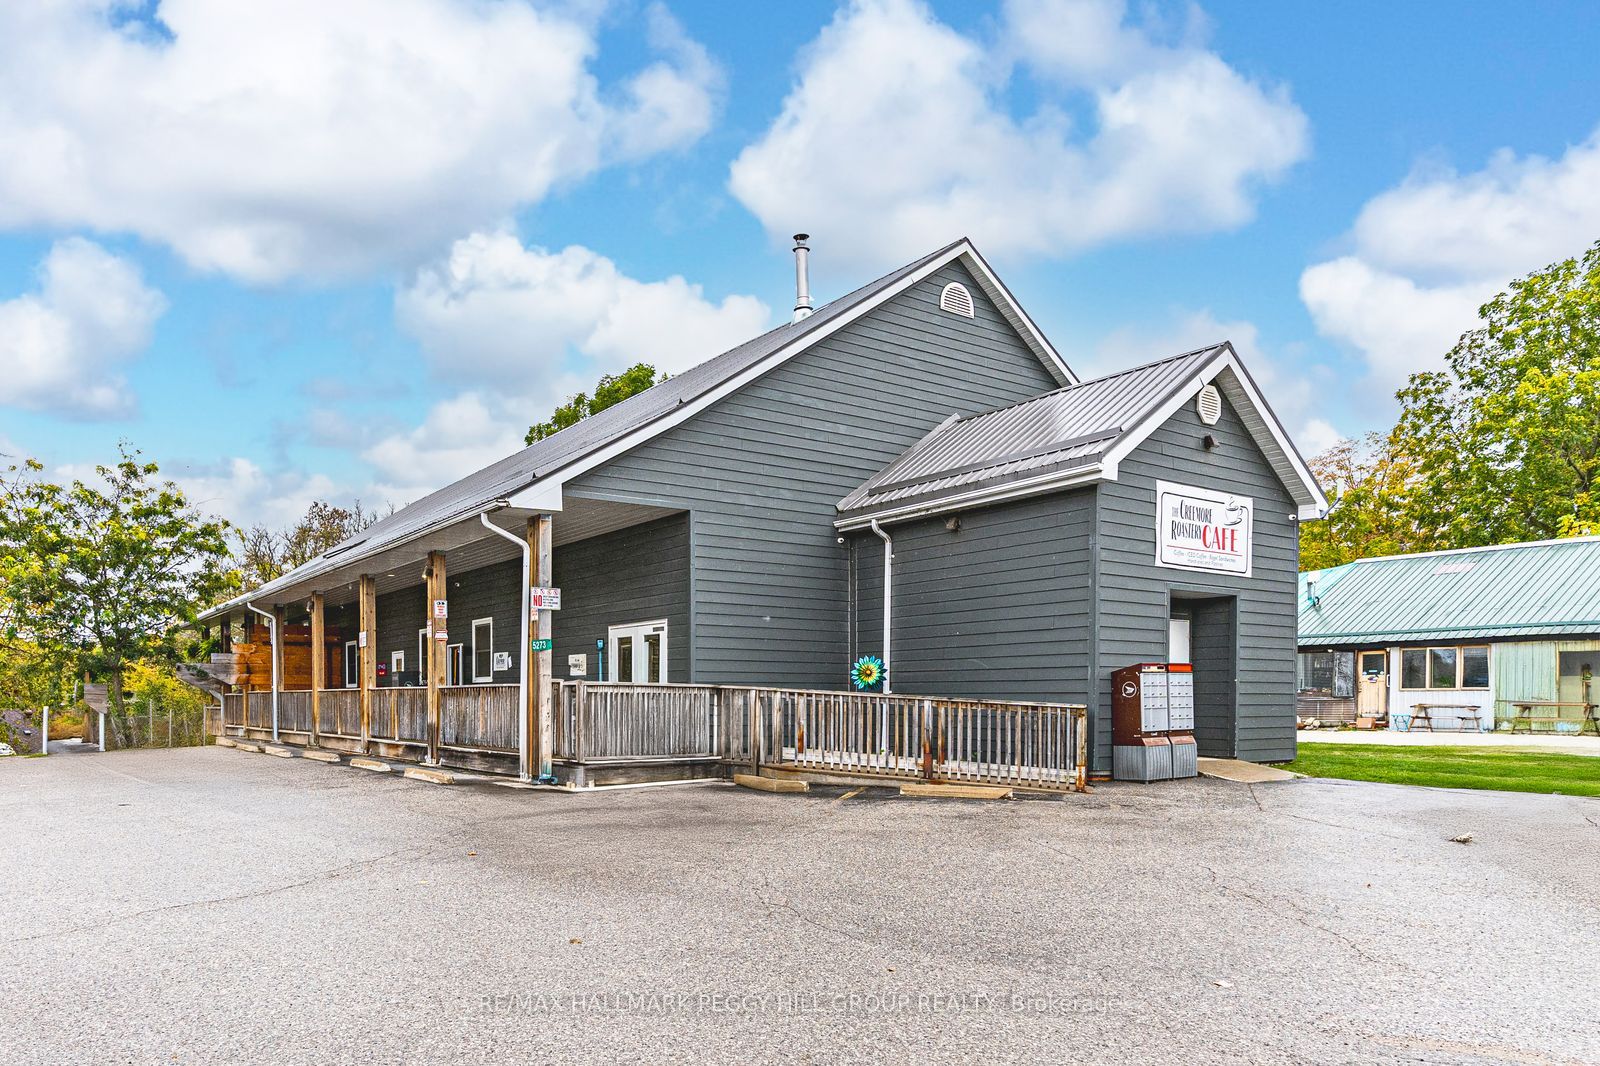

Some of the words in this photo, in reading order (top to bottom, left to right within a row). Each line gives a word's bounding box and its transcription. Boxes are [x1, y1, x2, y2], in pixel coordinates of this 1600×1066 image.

[1180, 500, 1212, 523] CREEMORE
[1172, 520, 1201, 540] ROASTERY
[1202, 525, 1238, 552] CAFE
[533, 595, 542, 606] NO
[532, 641, 546, 650] 5273
